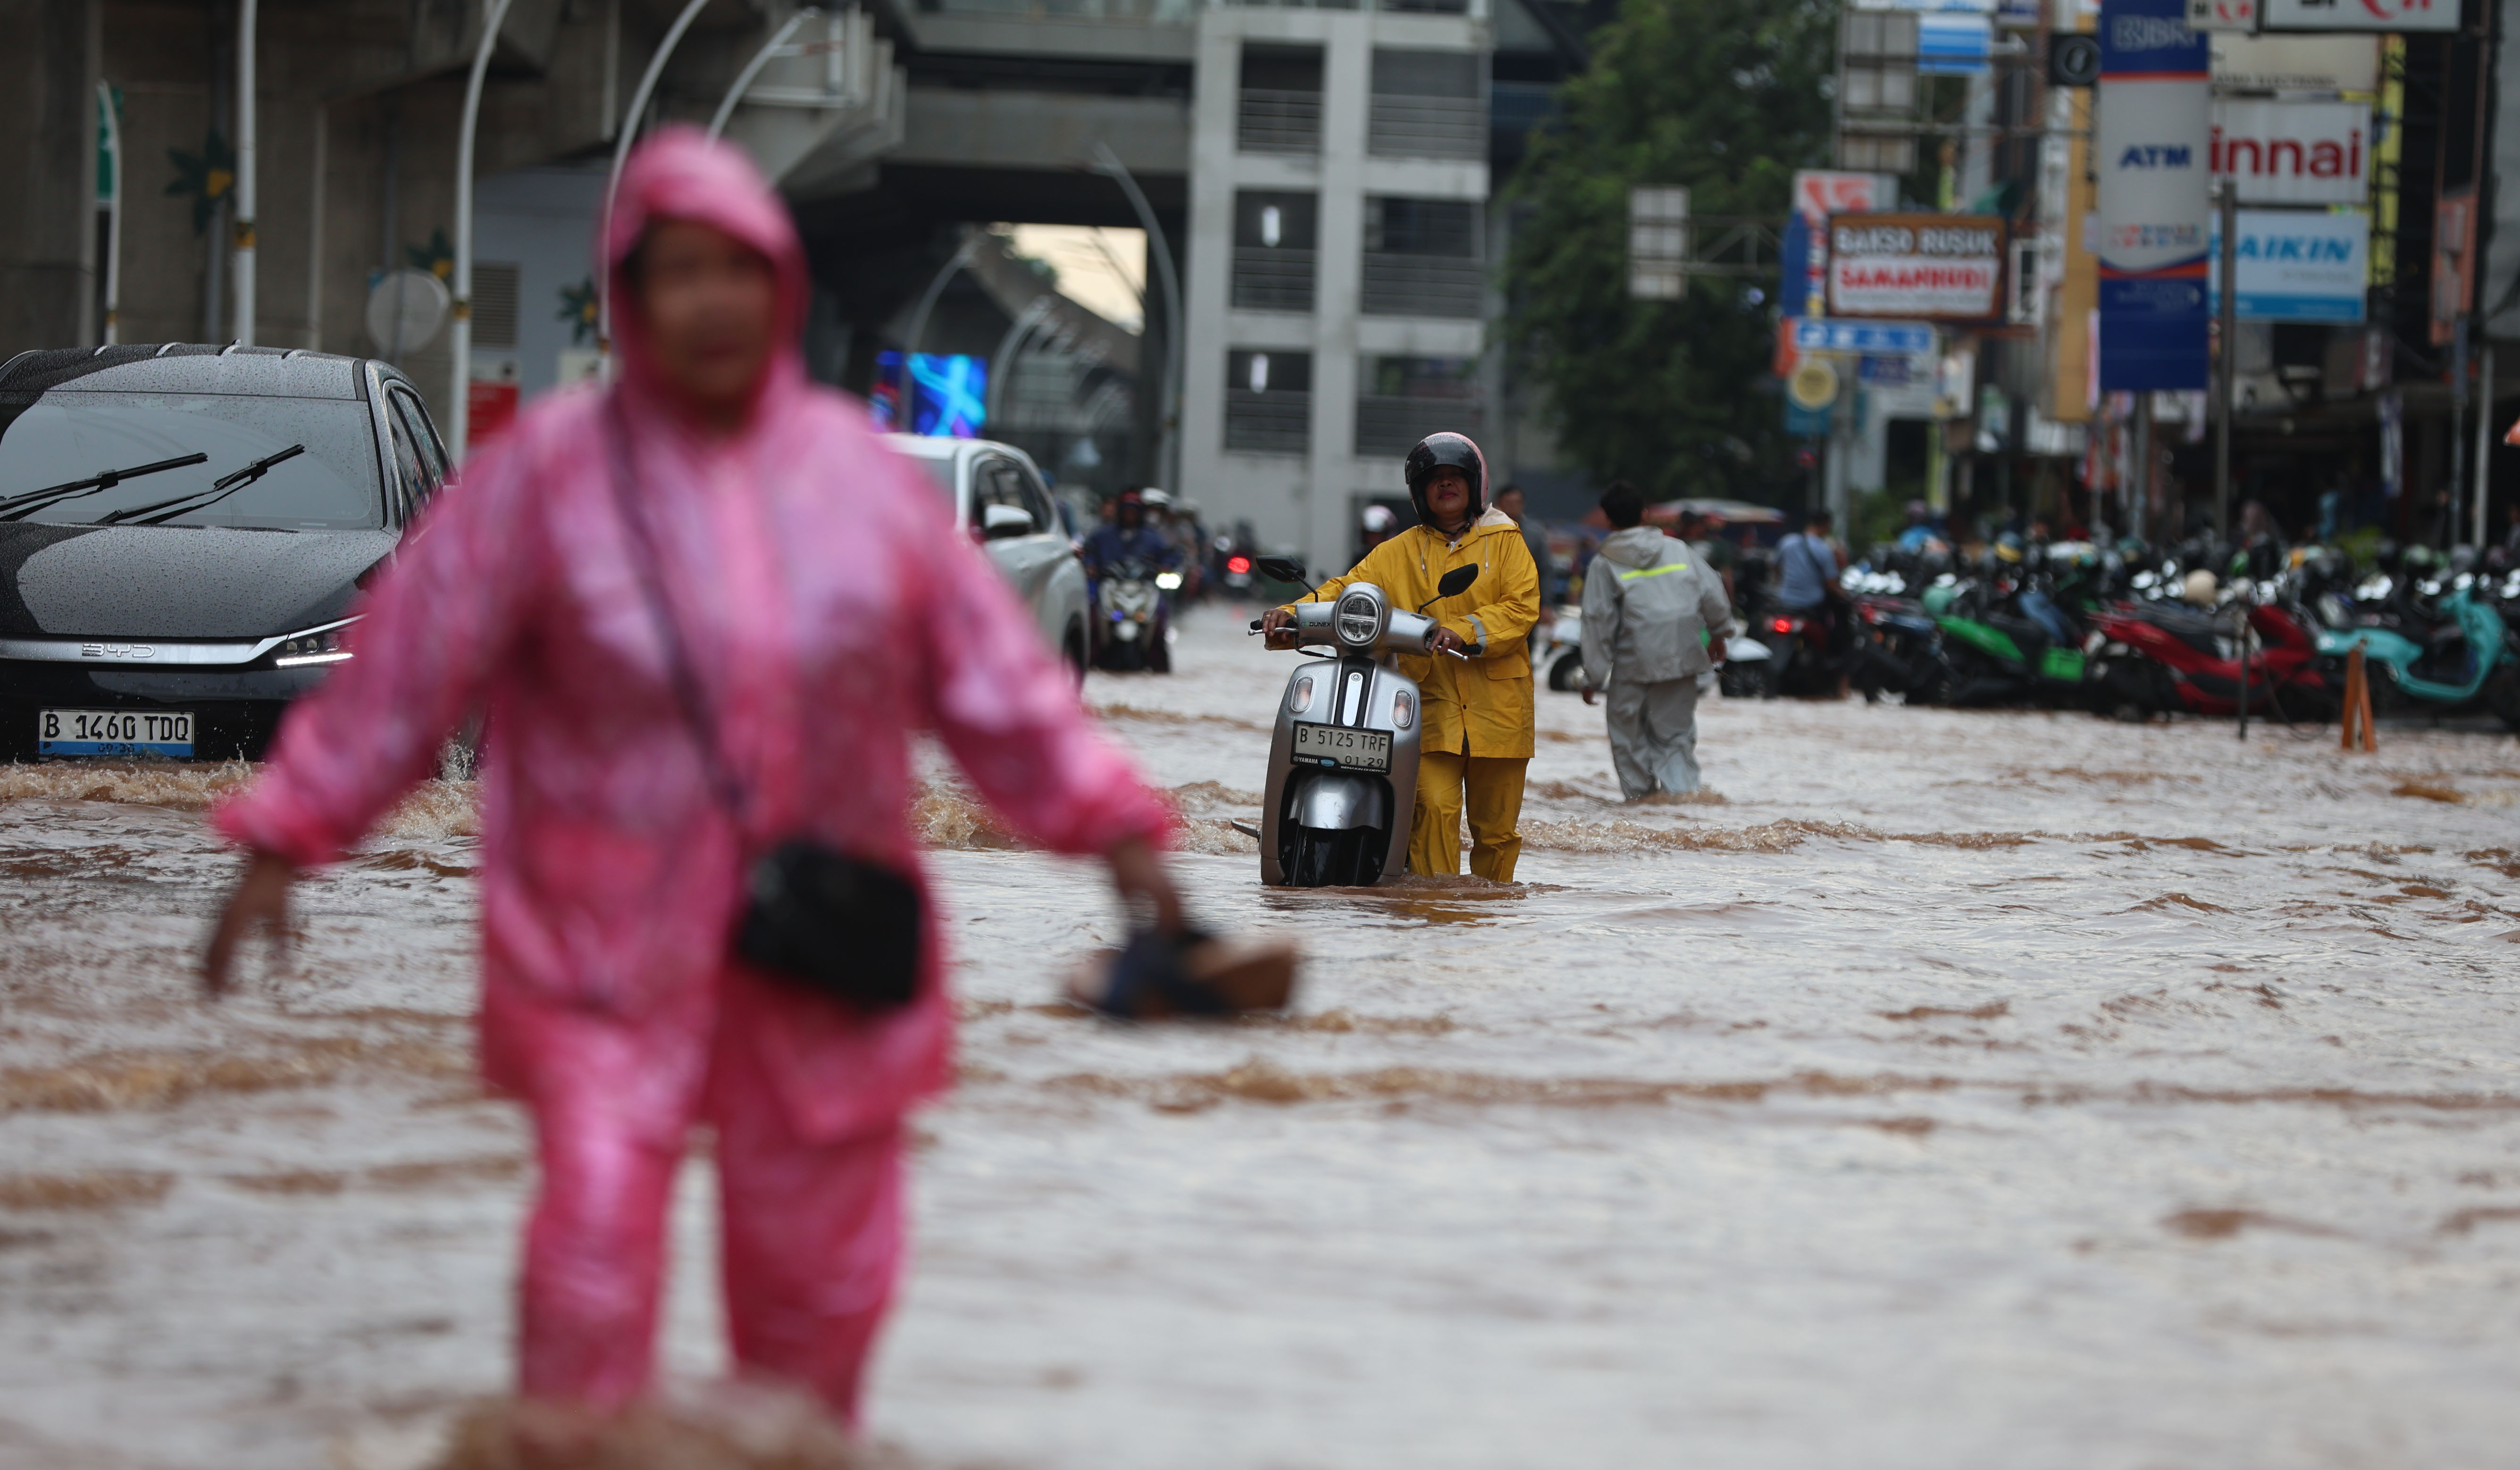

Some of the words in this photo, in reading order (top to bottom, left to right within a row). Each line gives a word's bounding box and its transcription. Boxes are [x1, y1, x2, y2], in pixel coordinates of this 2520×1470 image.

[2120, 146, 2191, 170] ATM
[1836, 226, 1914, 255] BAKSO
[1918, 226, 1997, 255] RUSUK
[1841, 264, 1989, 290] SAMANHUDI
[82, 643, 155, 658] BYD
[44, 714, 60, 738] B
[75, 715, 136, 740] 1460
[143, 716, 189, 741] TDQ
[1300, 728, 1308, 743] B
[1318, 730, 1353, 747] 5125
[1361, 735, 1386, 752] TRF
